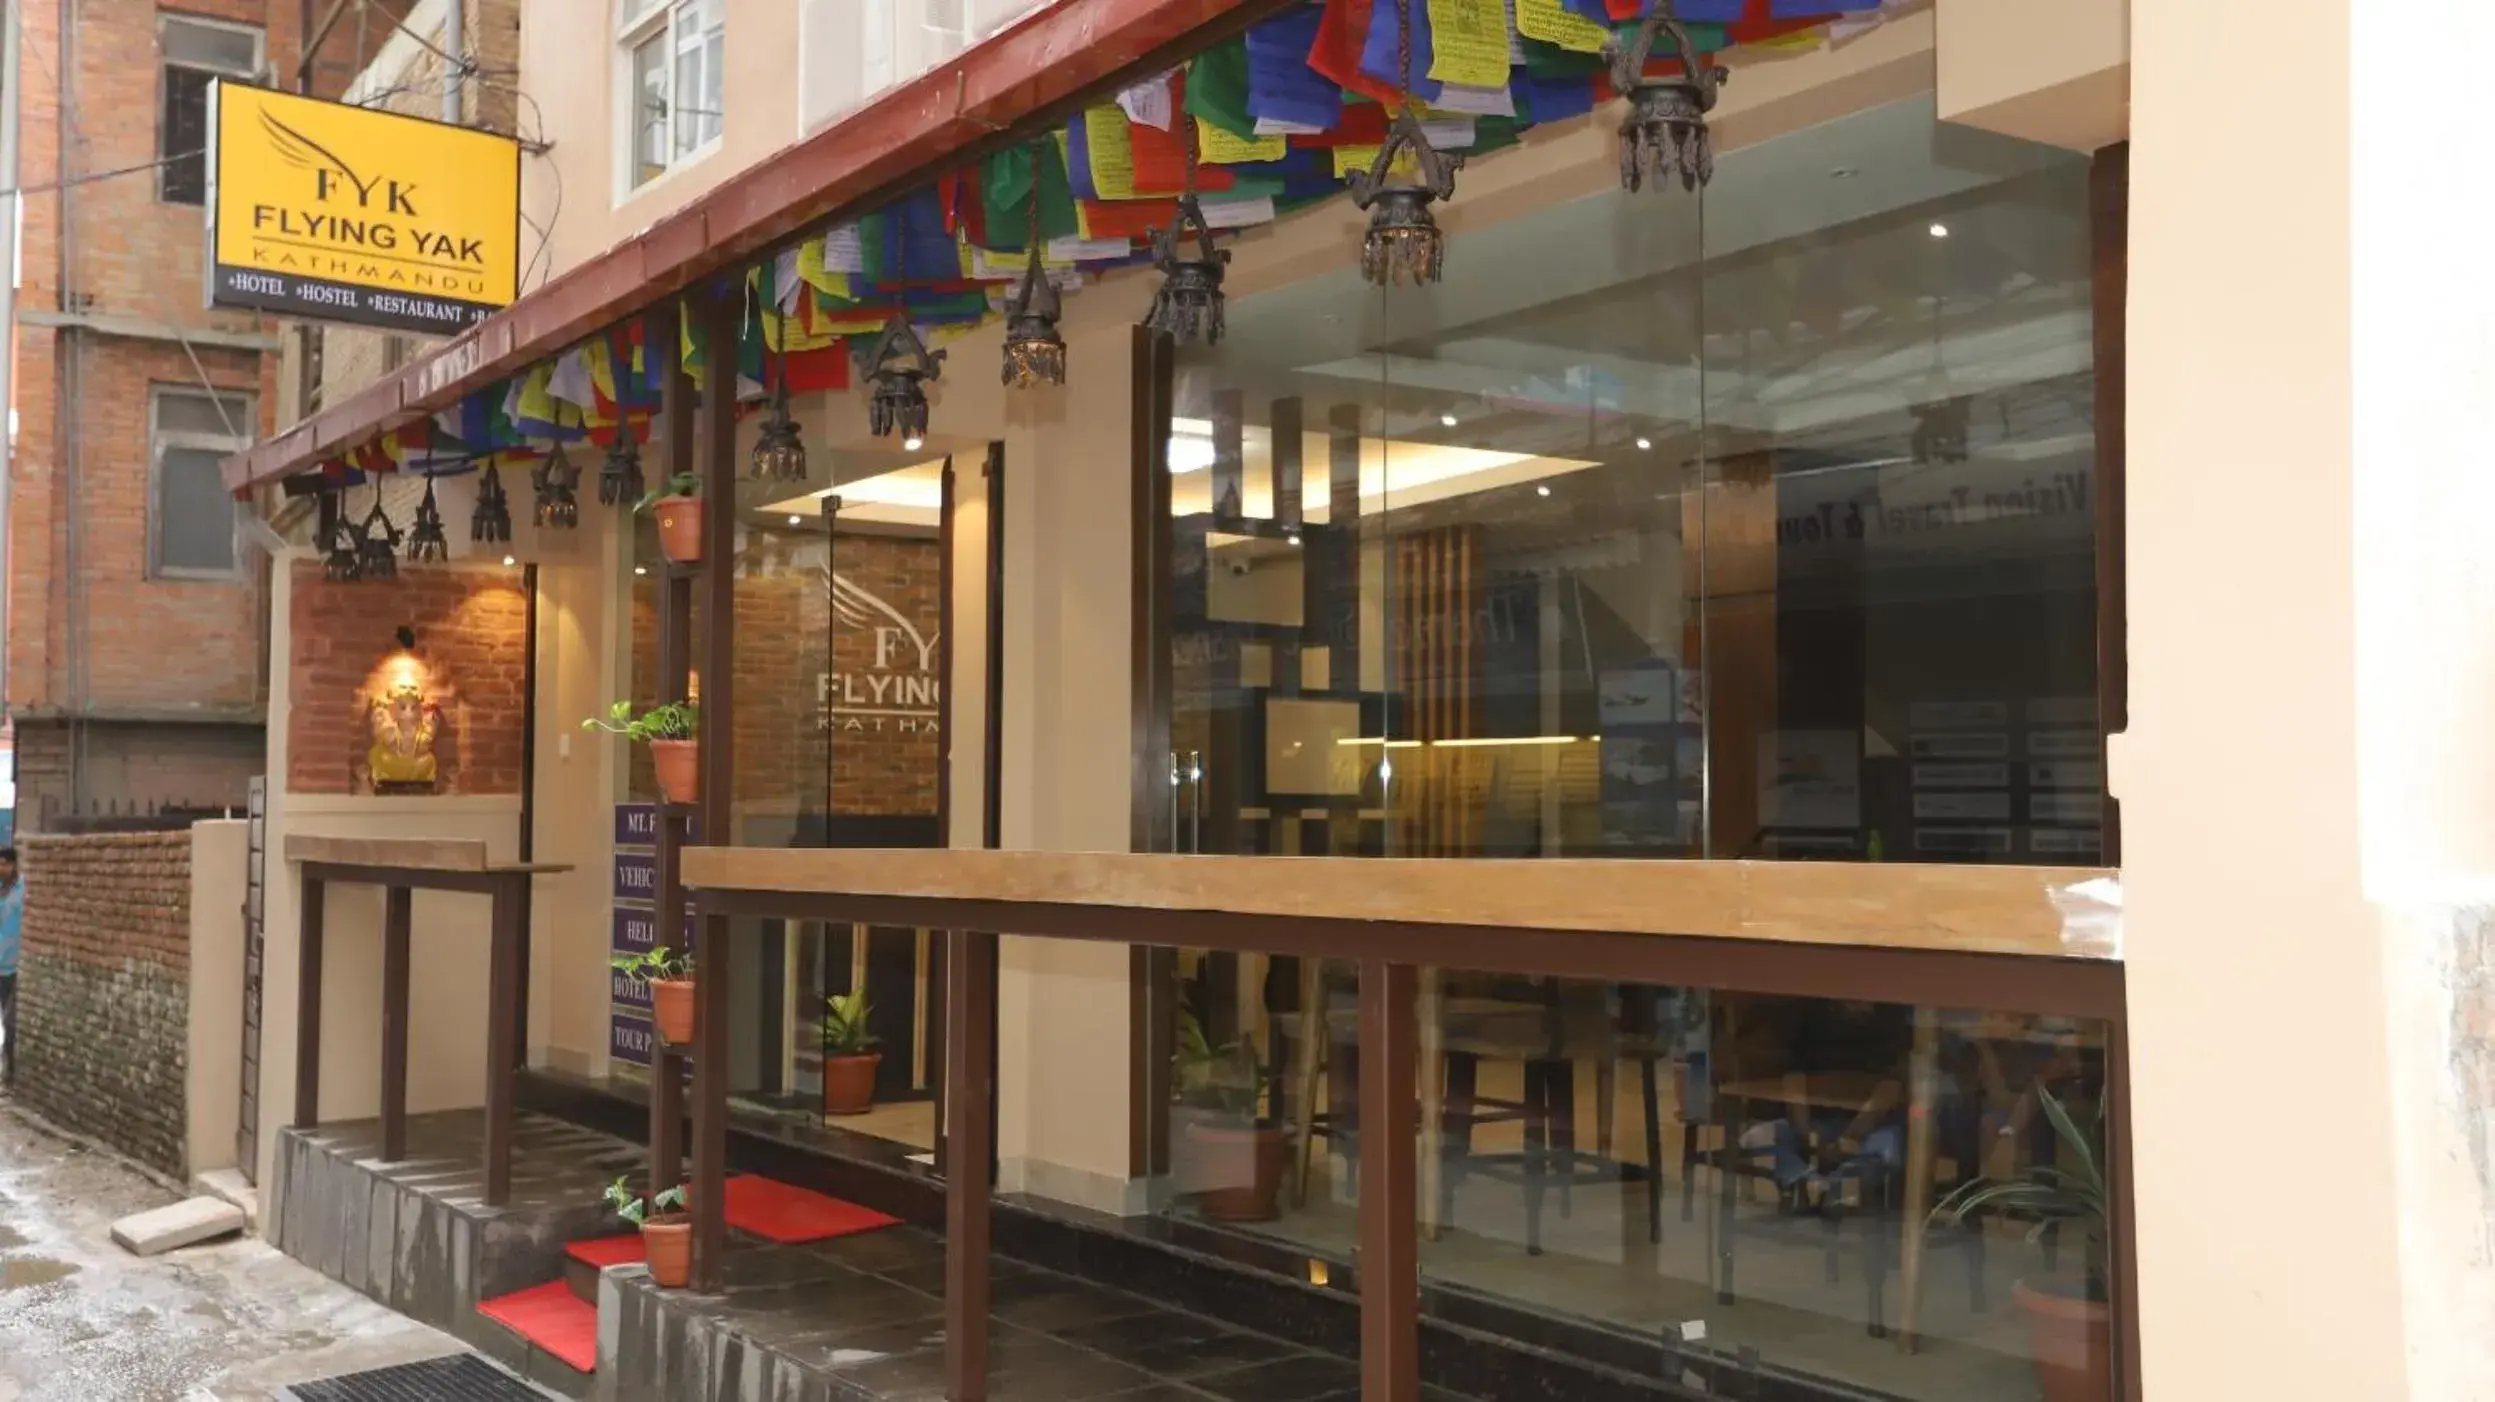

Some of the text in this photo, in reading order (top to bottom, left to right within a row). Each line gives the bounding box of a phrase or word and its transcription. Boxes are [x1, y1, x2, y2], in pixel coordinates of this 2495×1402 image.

[315, 167, 418, 217] FYK
[253, 204, 484, 264] FLYING YAK
[253, 246, 484, 294] KATHMANDU
[235, 274, 286, 297] HOTEL
[302, 282, 358, 308] HOSTEL
[374, 293, 463, 323] RESTAURANT
[873, 626, 940, 670] FY
[619, 866, 655, 888] VEHIC
[628, 920, 653, 942] HELI
